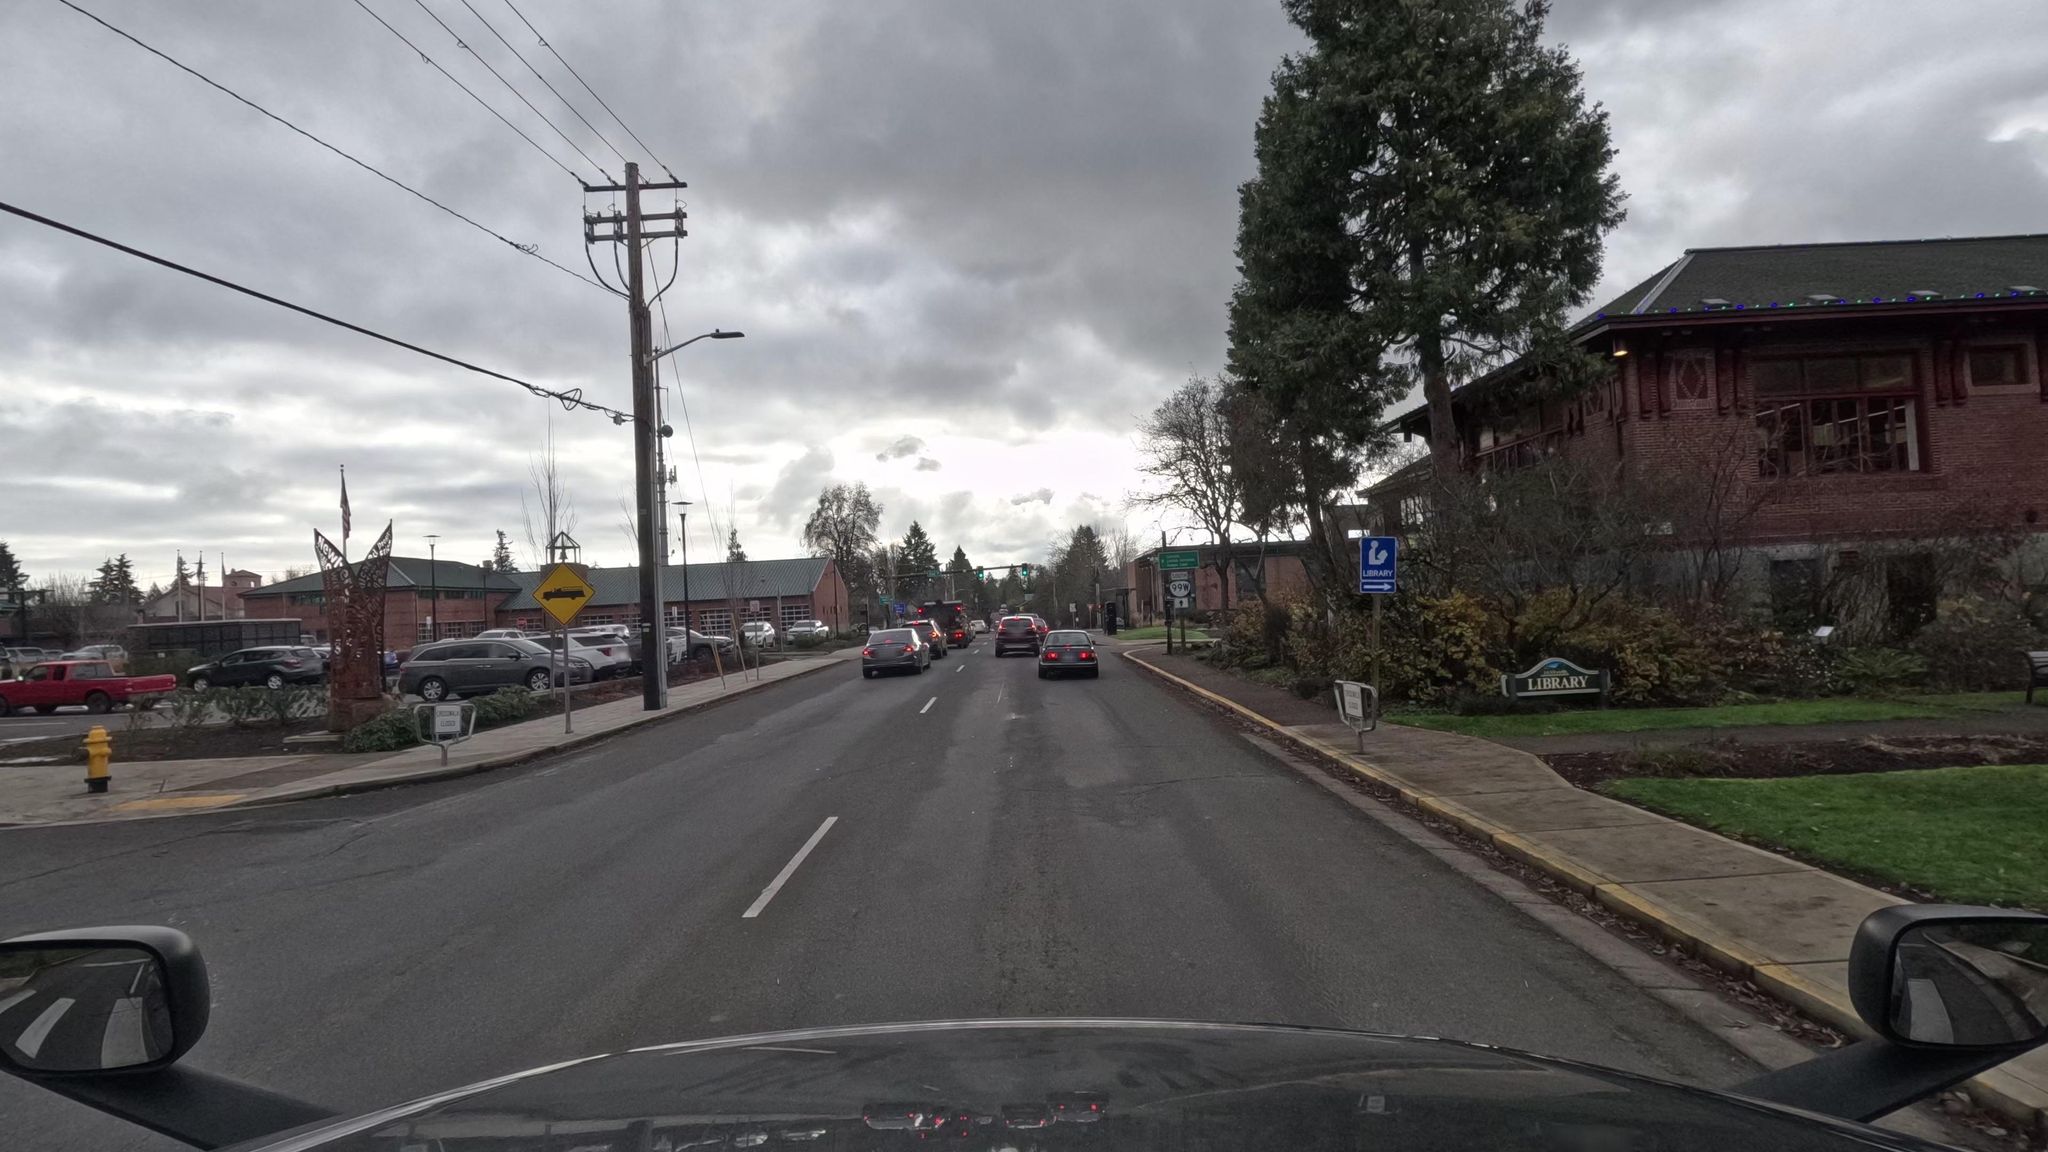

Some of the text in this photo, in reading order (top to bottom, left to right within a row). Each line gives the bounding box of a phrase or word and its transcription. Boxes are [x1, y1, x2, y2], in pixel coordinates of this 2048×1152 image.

[1362, 569, 1393, 577] LIBRARY
[1171, 583, 1190, 592] 99W
[1527, 675, 1589, 691] LIBRARY
